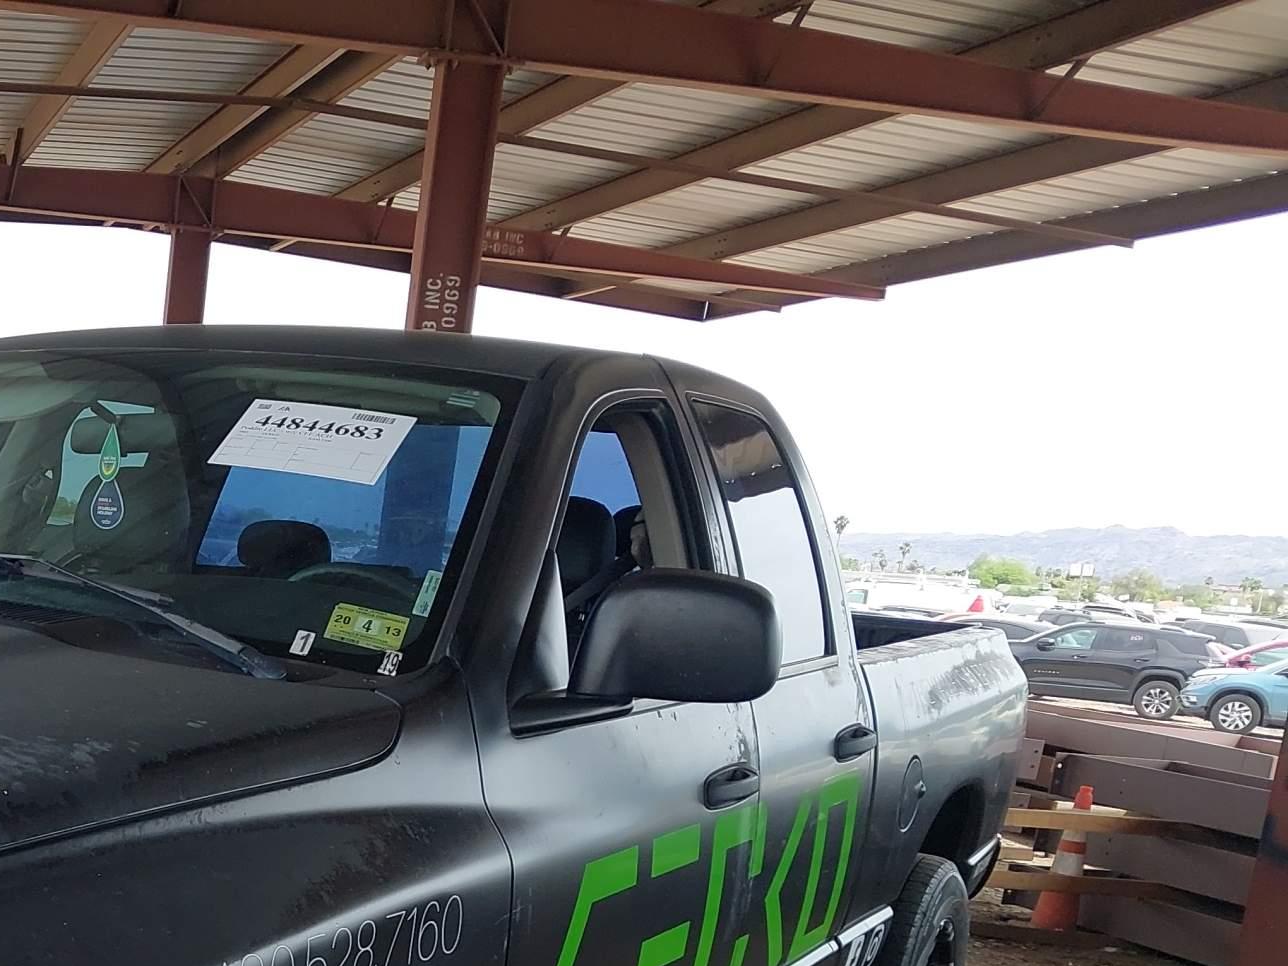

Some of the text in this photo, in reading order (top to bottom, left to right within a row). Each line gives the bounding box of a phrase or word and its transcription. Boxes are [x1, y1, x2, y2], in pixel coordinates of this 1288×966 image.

[424, 272, 444, 310] INC.
[441, 275, 461, 328] 0969
[254, 414, 385, 441] 44844683
[334, 614, 351, 625] 20
[362, 619, 373, 632] 4
[385, 626, 401, 637] 13
[299, 633, 312, 653] 1
